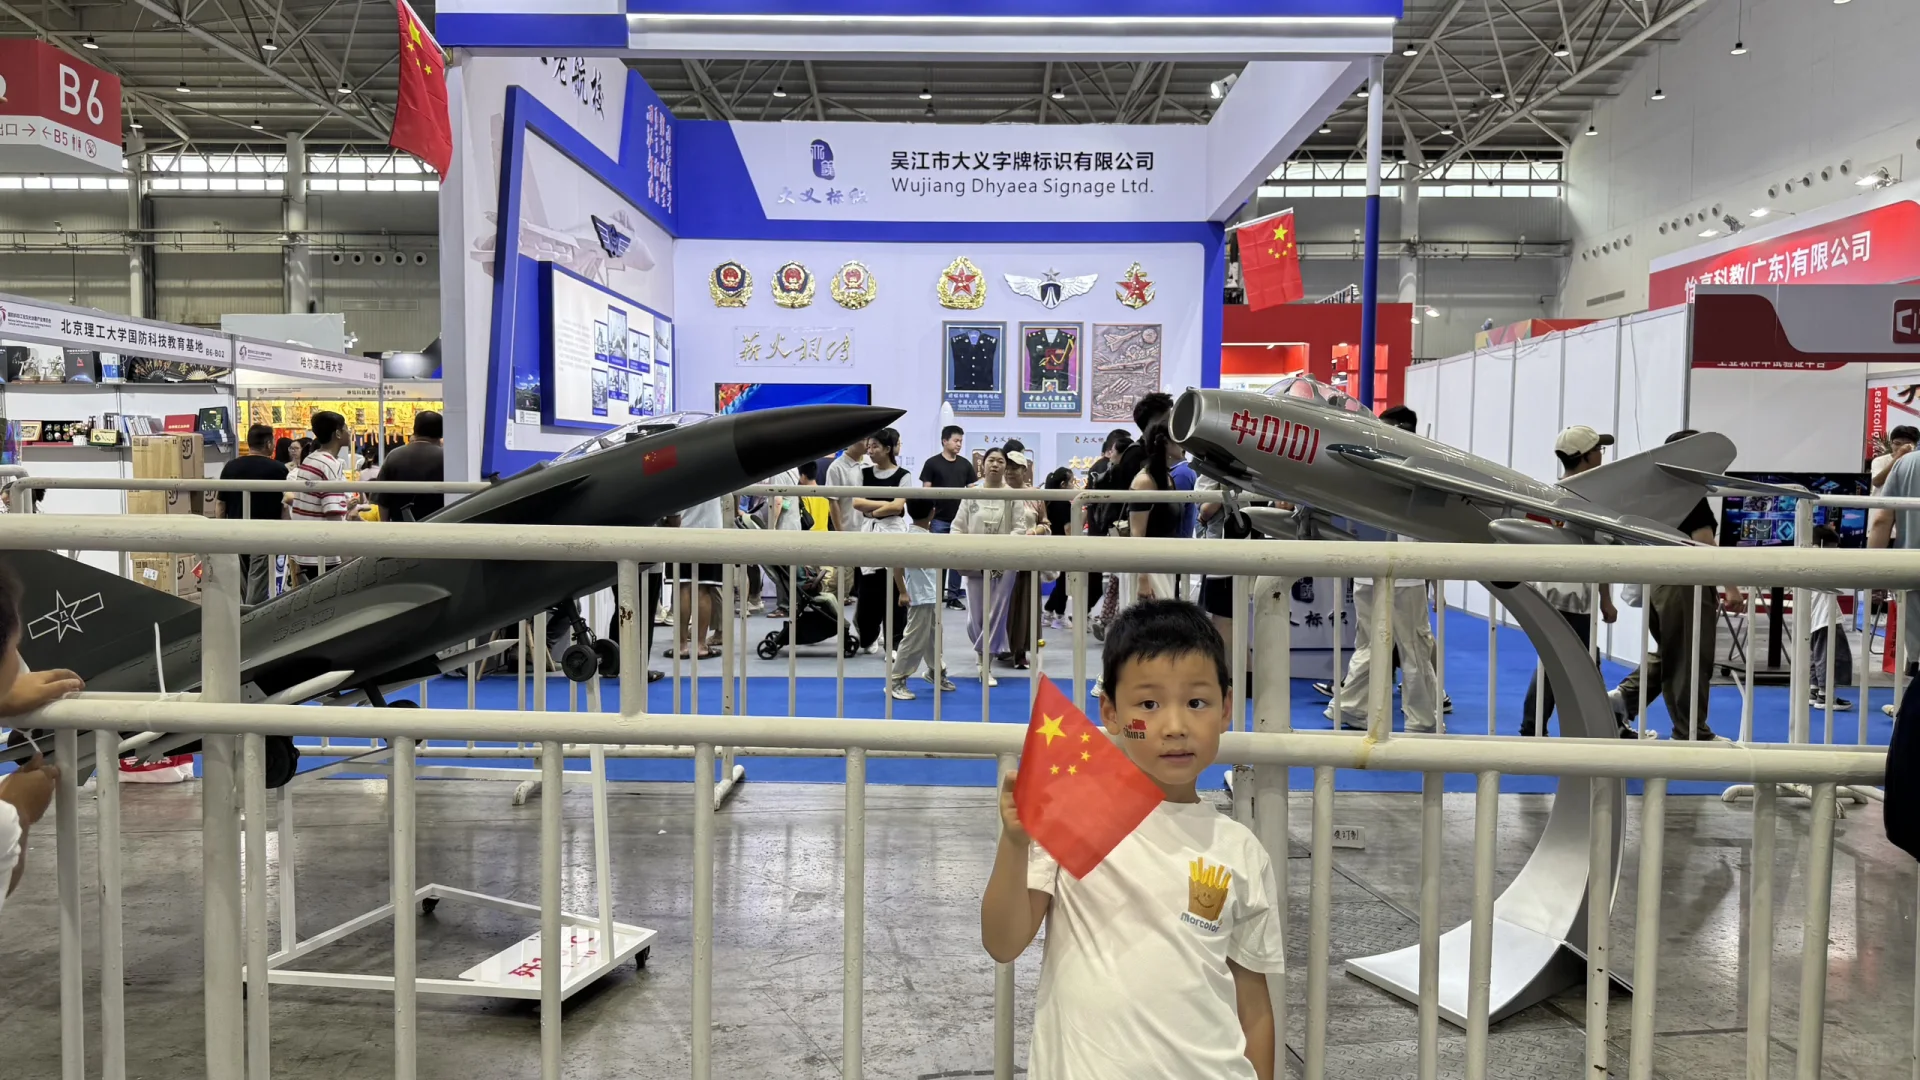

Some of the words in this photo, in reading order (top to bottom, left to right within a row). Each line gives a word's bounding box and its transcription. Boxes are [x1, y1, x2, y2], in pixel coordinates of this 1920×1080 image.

[59, 63, 104, 125] B6
[541, 56, 605, 121] 老航校
[0, 123, 18, 137] 口
[54, 128, 68, 146] B5
[890, 150, 1155, 171] 吴江市大义字牌标识有限公司
[891, 177, 966, 197] Wujiang
[971, 177, 1038, 196] Dhyaea
[1043, 177, 1116, 196] Signage
[1121, 178, 1154, 194] Ltd.
[61, 318, 204, 353] 北京理工大学国防科技教育基地
[205, 347, 225, 358] B6-B02
[300, 356, 344, 373] 哈尔滨工程大学
[1230, 409, 1321, 466] 中0101
[1290, 609, 1348, 628] 标识
